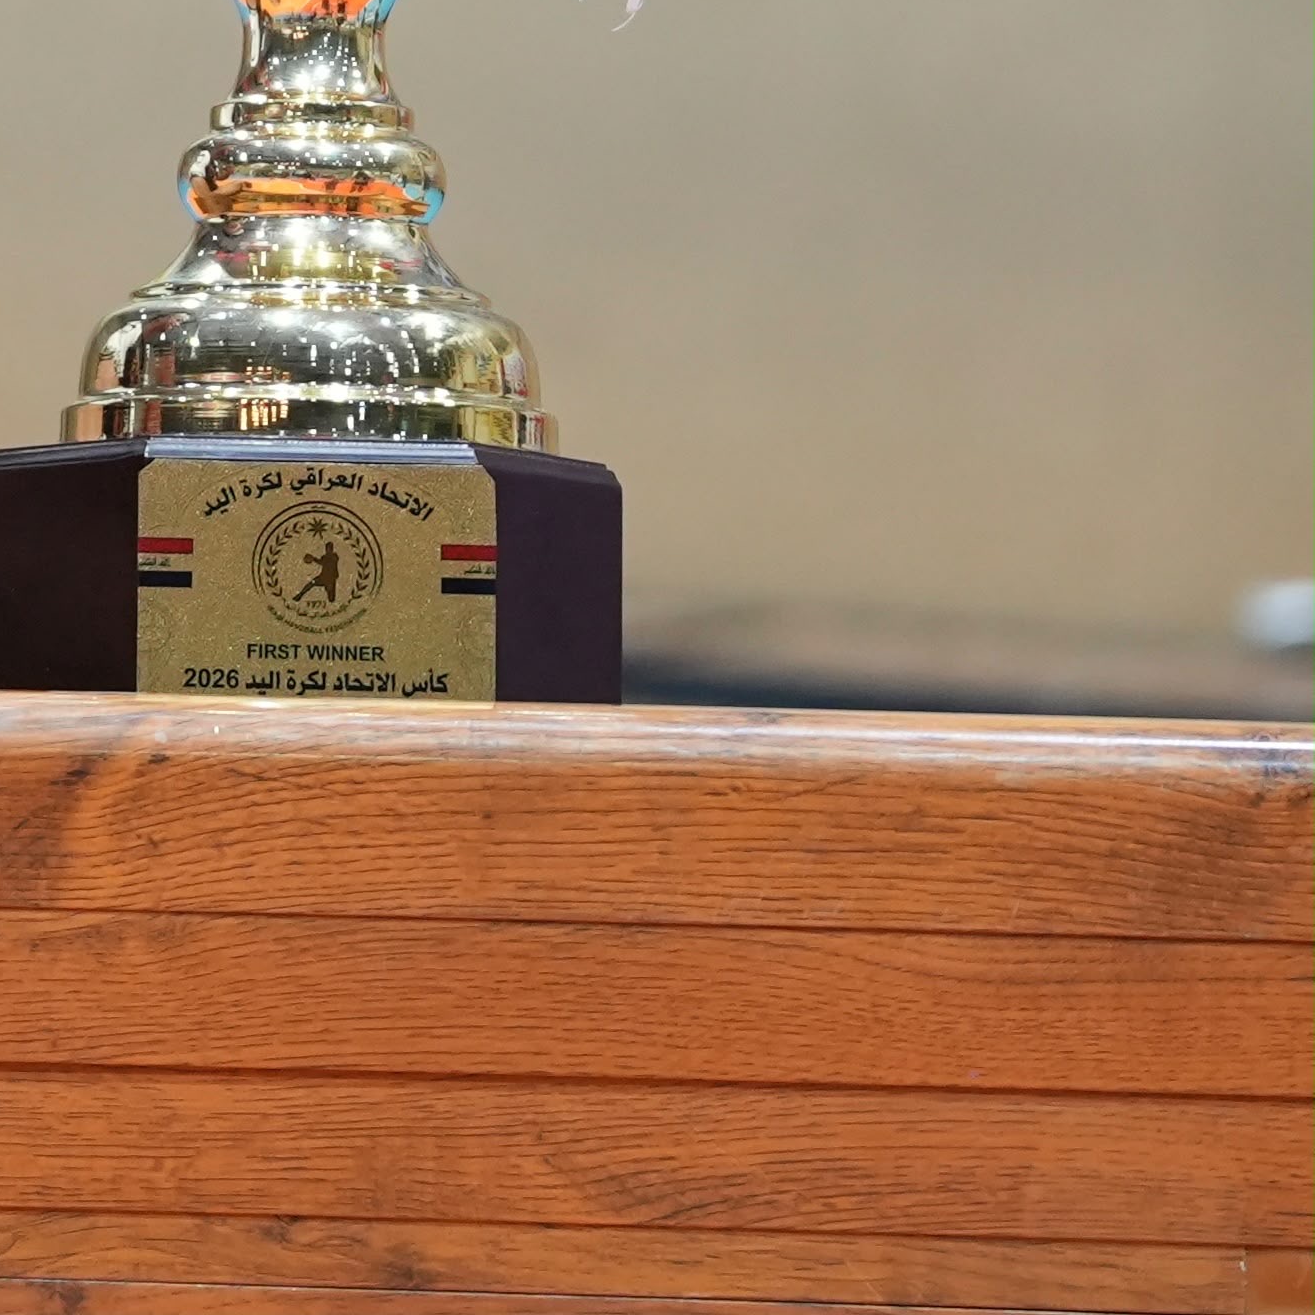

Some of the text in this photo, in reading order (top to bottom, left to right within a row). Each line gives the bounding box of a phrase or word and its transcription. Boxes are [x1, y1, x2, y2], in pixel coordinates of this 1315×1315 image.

[204, 467, 435, 521] الاتحاد العراقي لكرة اليد
[247, 643, 386, 662] FIRST WINNER
[183, 667, 449, 697] كأس الاتحاد لكرة اليد 2026
